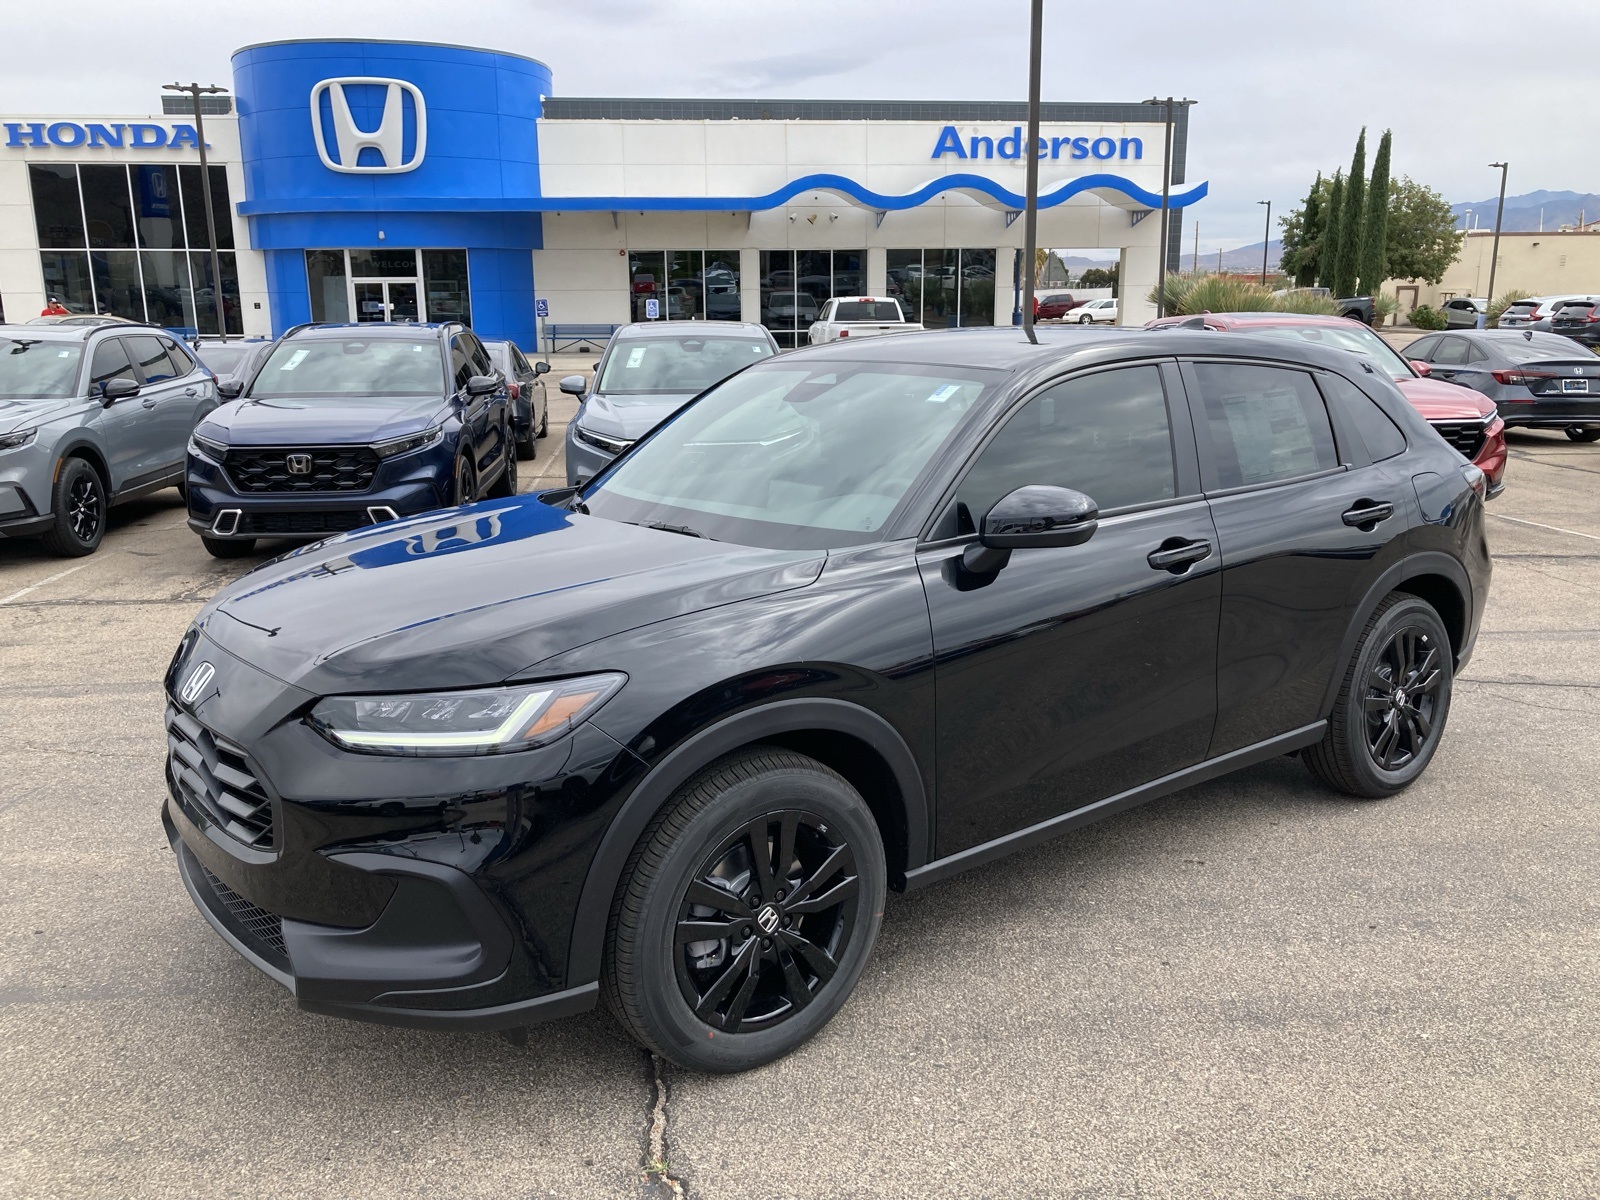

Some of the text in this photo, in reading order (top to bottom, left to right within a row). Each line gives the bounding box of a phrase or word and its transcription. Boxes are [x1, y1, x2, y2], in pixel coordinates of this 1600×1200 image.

[3, 122, 211, 148] HONDA
[931, 125, 1143, 160] Anderson
[372, 260, 416, 268] WELCOM
